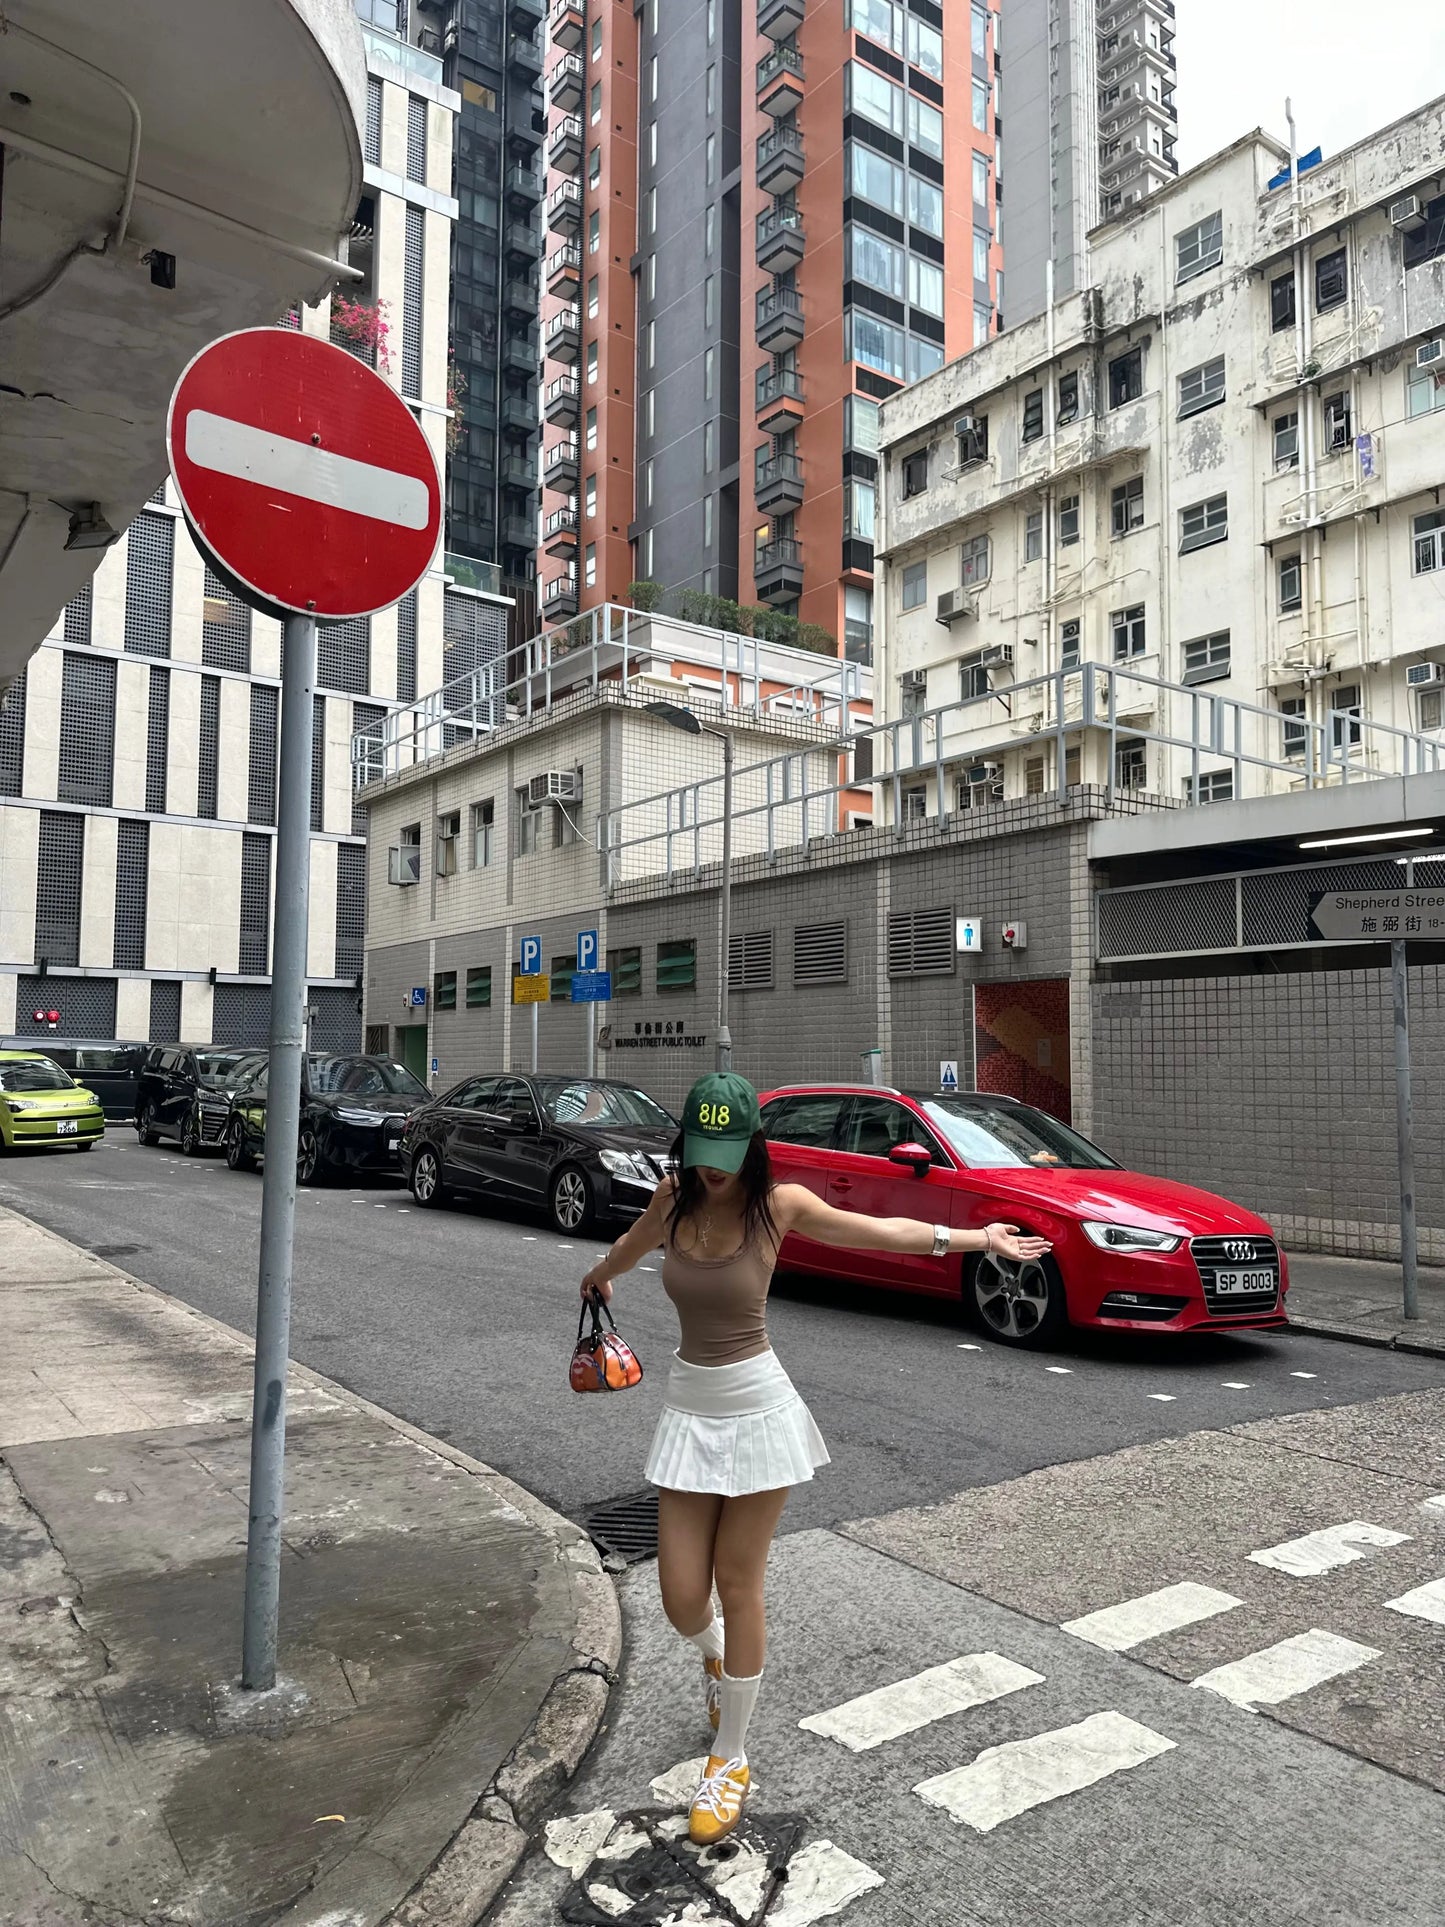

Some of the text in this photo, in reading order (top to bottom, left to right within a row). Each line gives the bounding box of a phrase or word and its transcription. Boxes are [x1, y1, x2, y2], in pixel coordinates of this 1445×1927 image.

[1336, 896, 1400, 910] Shepherd
[1361, 915, 1422, 932] 施弼街
[524, 940, 538, 971] P
[581, 935, 594, 967] P
[639, 1037, 661, 1048] STREET
[662, 1036, 683, 1048] PUBLIC
[684, 1036, 706, 1047] TOILET
[699, 1103, 730, 1126] 818
[1220, 1272, 1271, 1291] SP 8003
